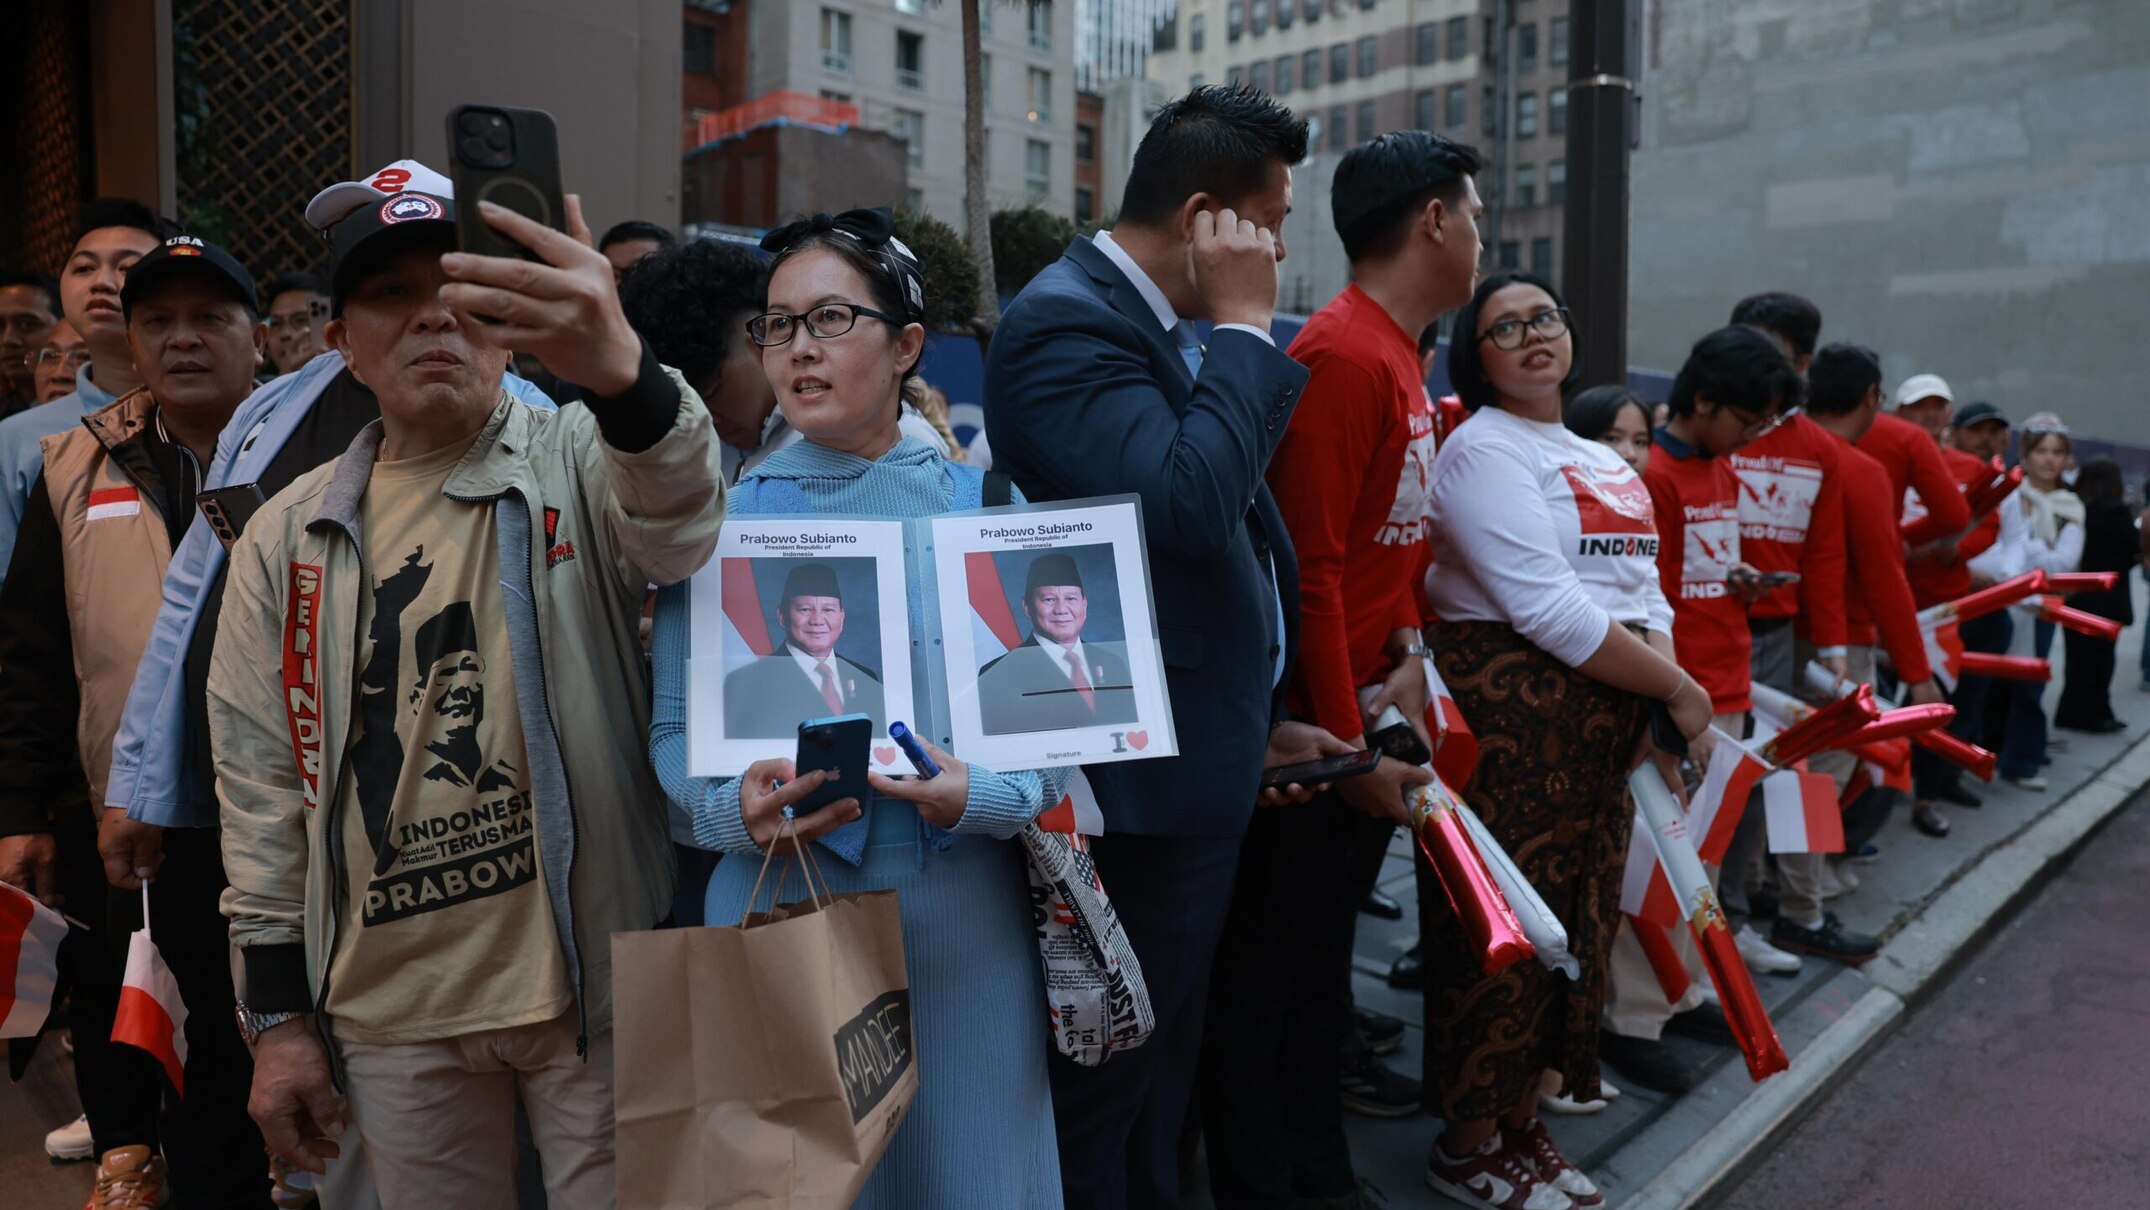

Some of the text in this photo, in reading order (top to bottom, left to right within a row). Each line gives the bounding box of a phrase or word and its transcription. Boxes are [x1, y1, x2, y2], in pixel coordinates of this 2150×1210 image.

[371, 169, 412, 193] 2
[166, 235, 204, 247] USA
[740, 533, 857, 544] Prabowo Subianto
[980, 522, 1093, 538] Prabowo Subianto
[1110, 732, 1128, 753] I
[1046, 751, 1082, 760] Signature
[436, 827, 500, 858] TERUS
[402, 852, 438, 866] Makmur
[365, 846, 532, 918] PRABOW
[1061, 1004, 1078, 1028] the
[841, 1002, 907, 1109] MANDEE
